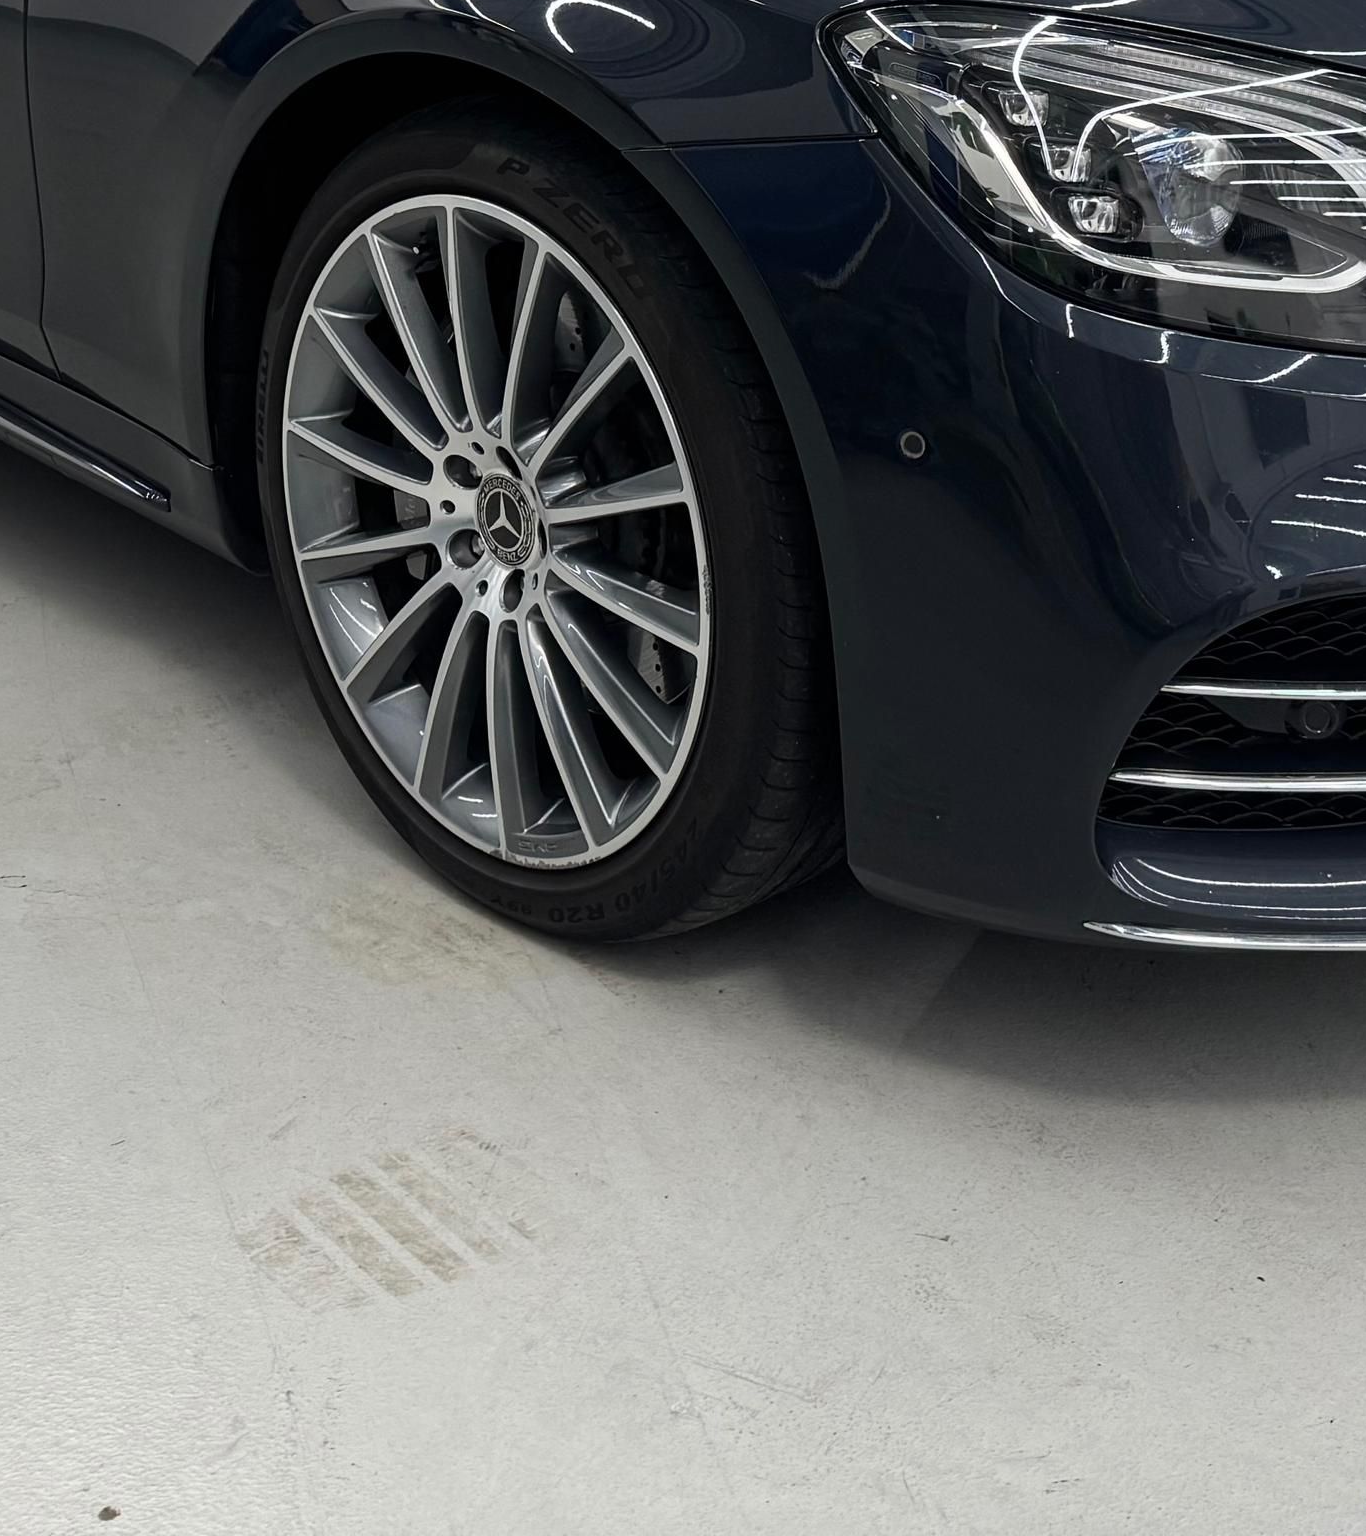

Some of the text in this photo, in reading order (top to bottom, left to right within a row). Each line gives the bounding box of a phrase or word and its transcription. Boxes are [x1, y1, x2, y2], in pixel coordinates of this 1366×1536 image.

[496, 157, 647, 300] P ZERO
[483, 478, 522, 501] MERCEDES
[496, 549, 517, 562] BENZ
[547, 901, 606, 924] R20
